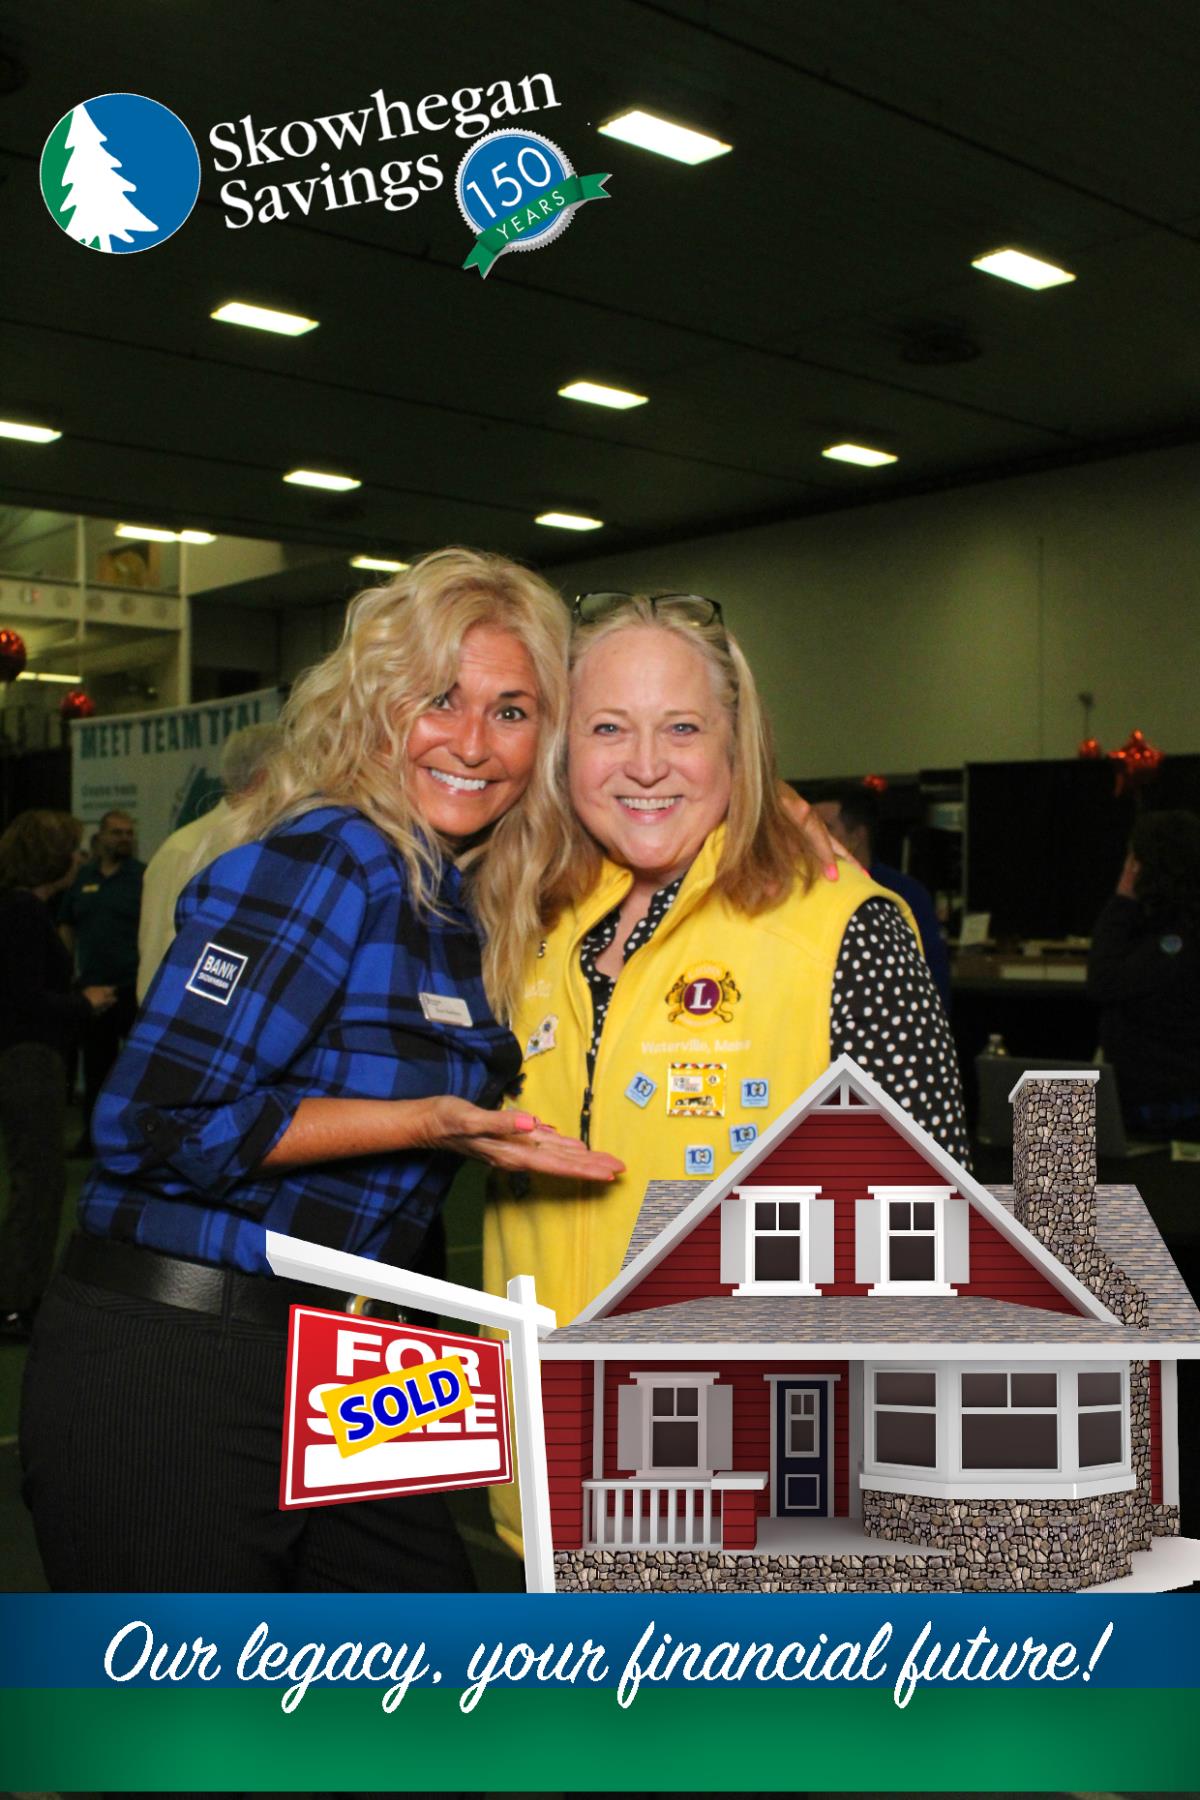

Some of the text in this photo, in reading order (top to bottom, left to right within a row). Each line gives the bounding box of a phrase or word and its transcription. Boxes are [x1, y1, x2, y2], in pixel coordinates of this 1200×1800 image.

[80, 724, 131, 759] MEET
[141, 712, 202, 754] TEAM
[203, 955, 238, 981] BANK
[689, 982, 712, 1009] L
